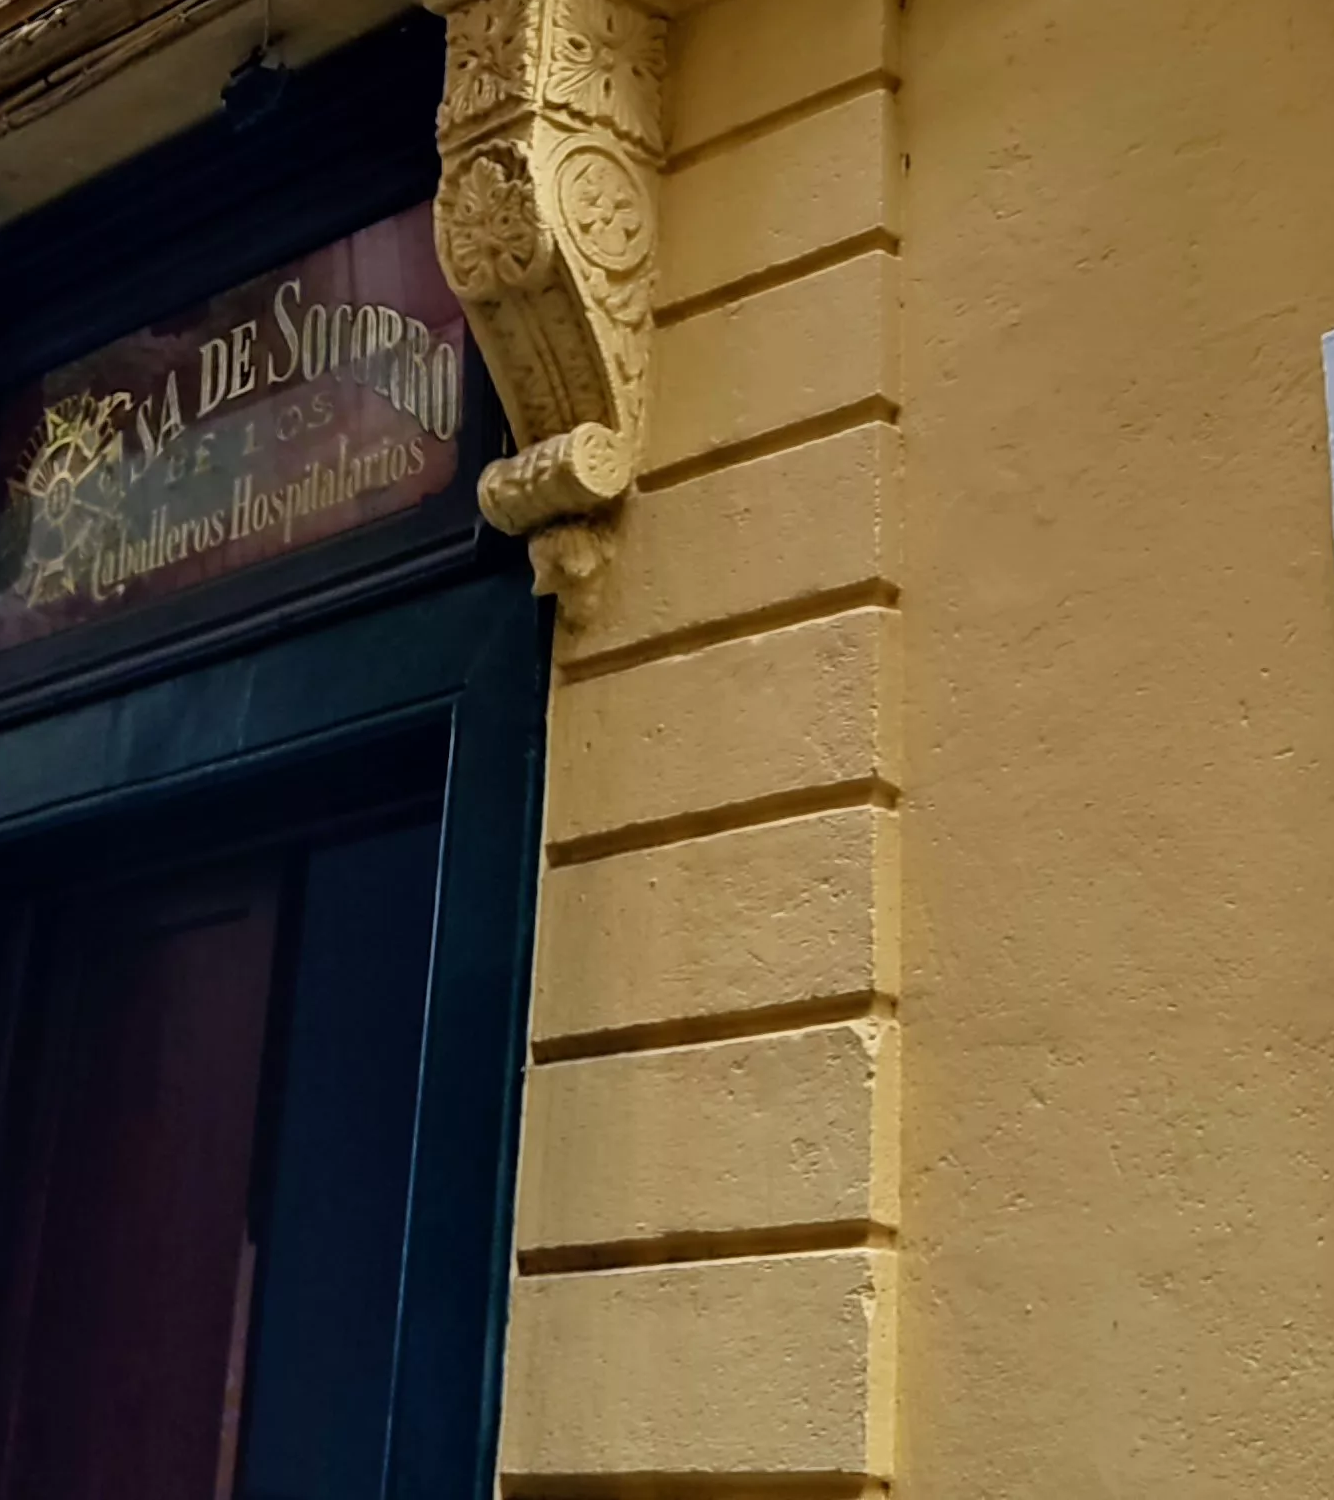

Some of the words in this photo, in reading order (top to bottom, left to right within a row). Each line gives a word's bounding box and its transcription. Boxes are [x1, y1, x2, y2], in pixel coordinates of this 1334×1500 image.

[196, 320, 258, 419] DE
[240, 390, 336, 458] LOS
[91, 503, 226, 602] Caballeros
[229, 433, 425, 544] Hospitalarios
